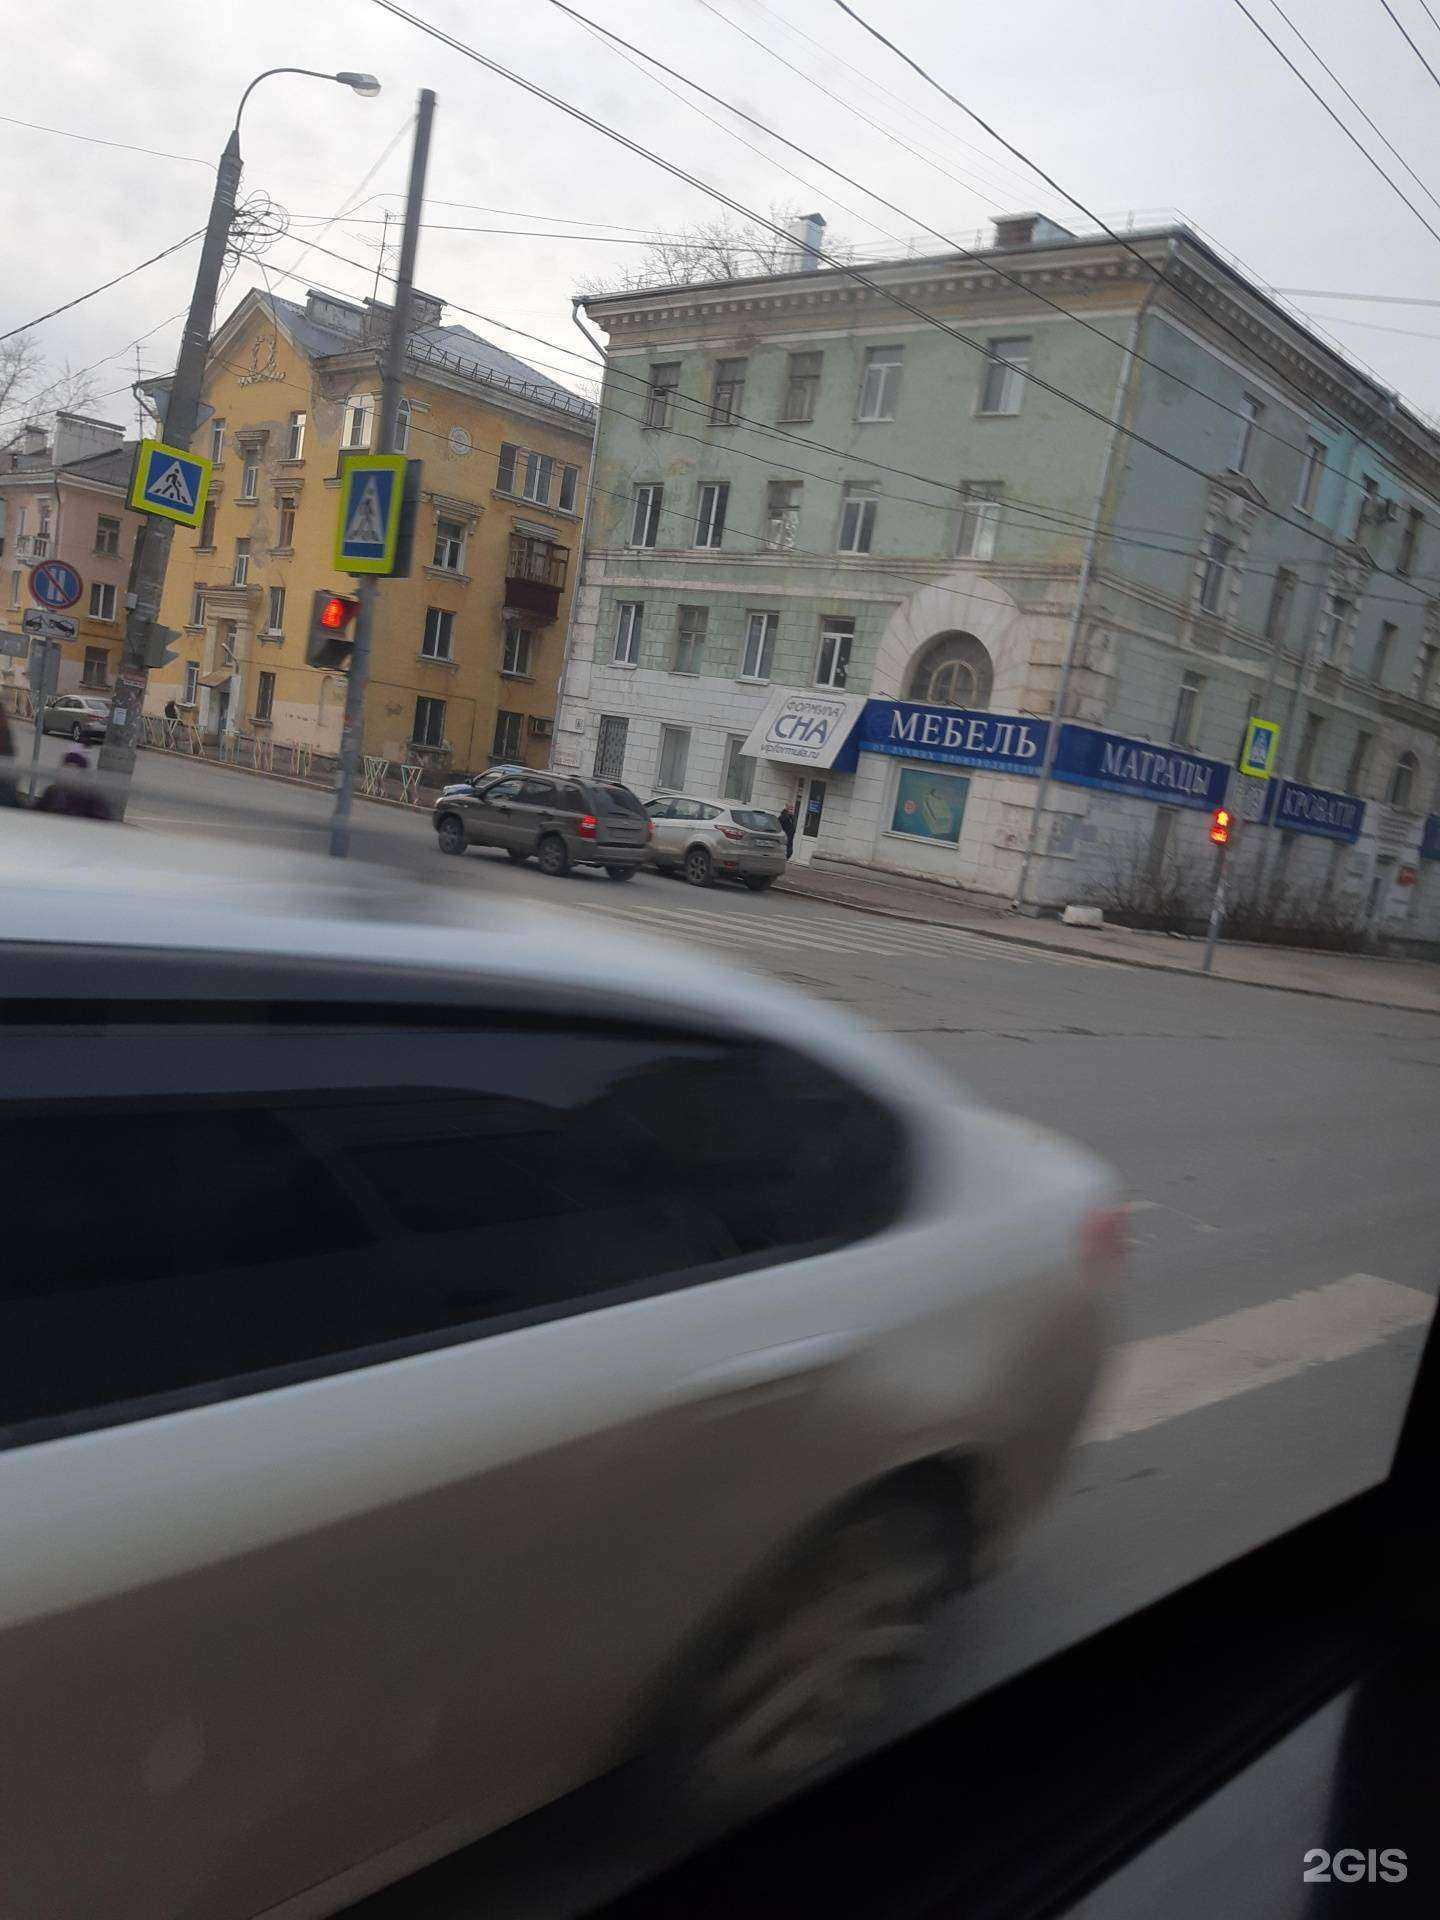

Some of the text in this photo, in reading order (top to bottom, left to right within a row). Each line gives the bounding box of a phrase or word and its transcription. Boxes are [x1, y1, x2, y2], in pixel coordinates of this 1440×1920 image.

[774, 714, 829, 743] СНА
[787, 702, 839, 718] ФОРМУЛА
[888, 709, 1037, 759] МЕБЕЛЬ
[1099, 741, 1213, 796] МАТРАЦЫ
